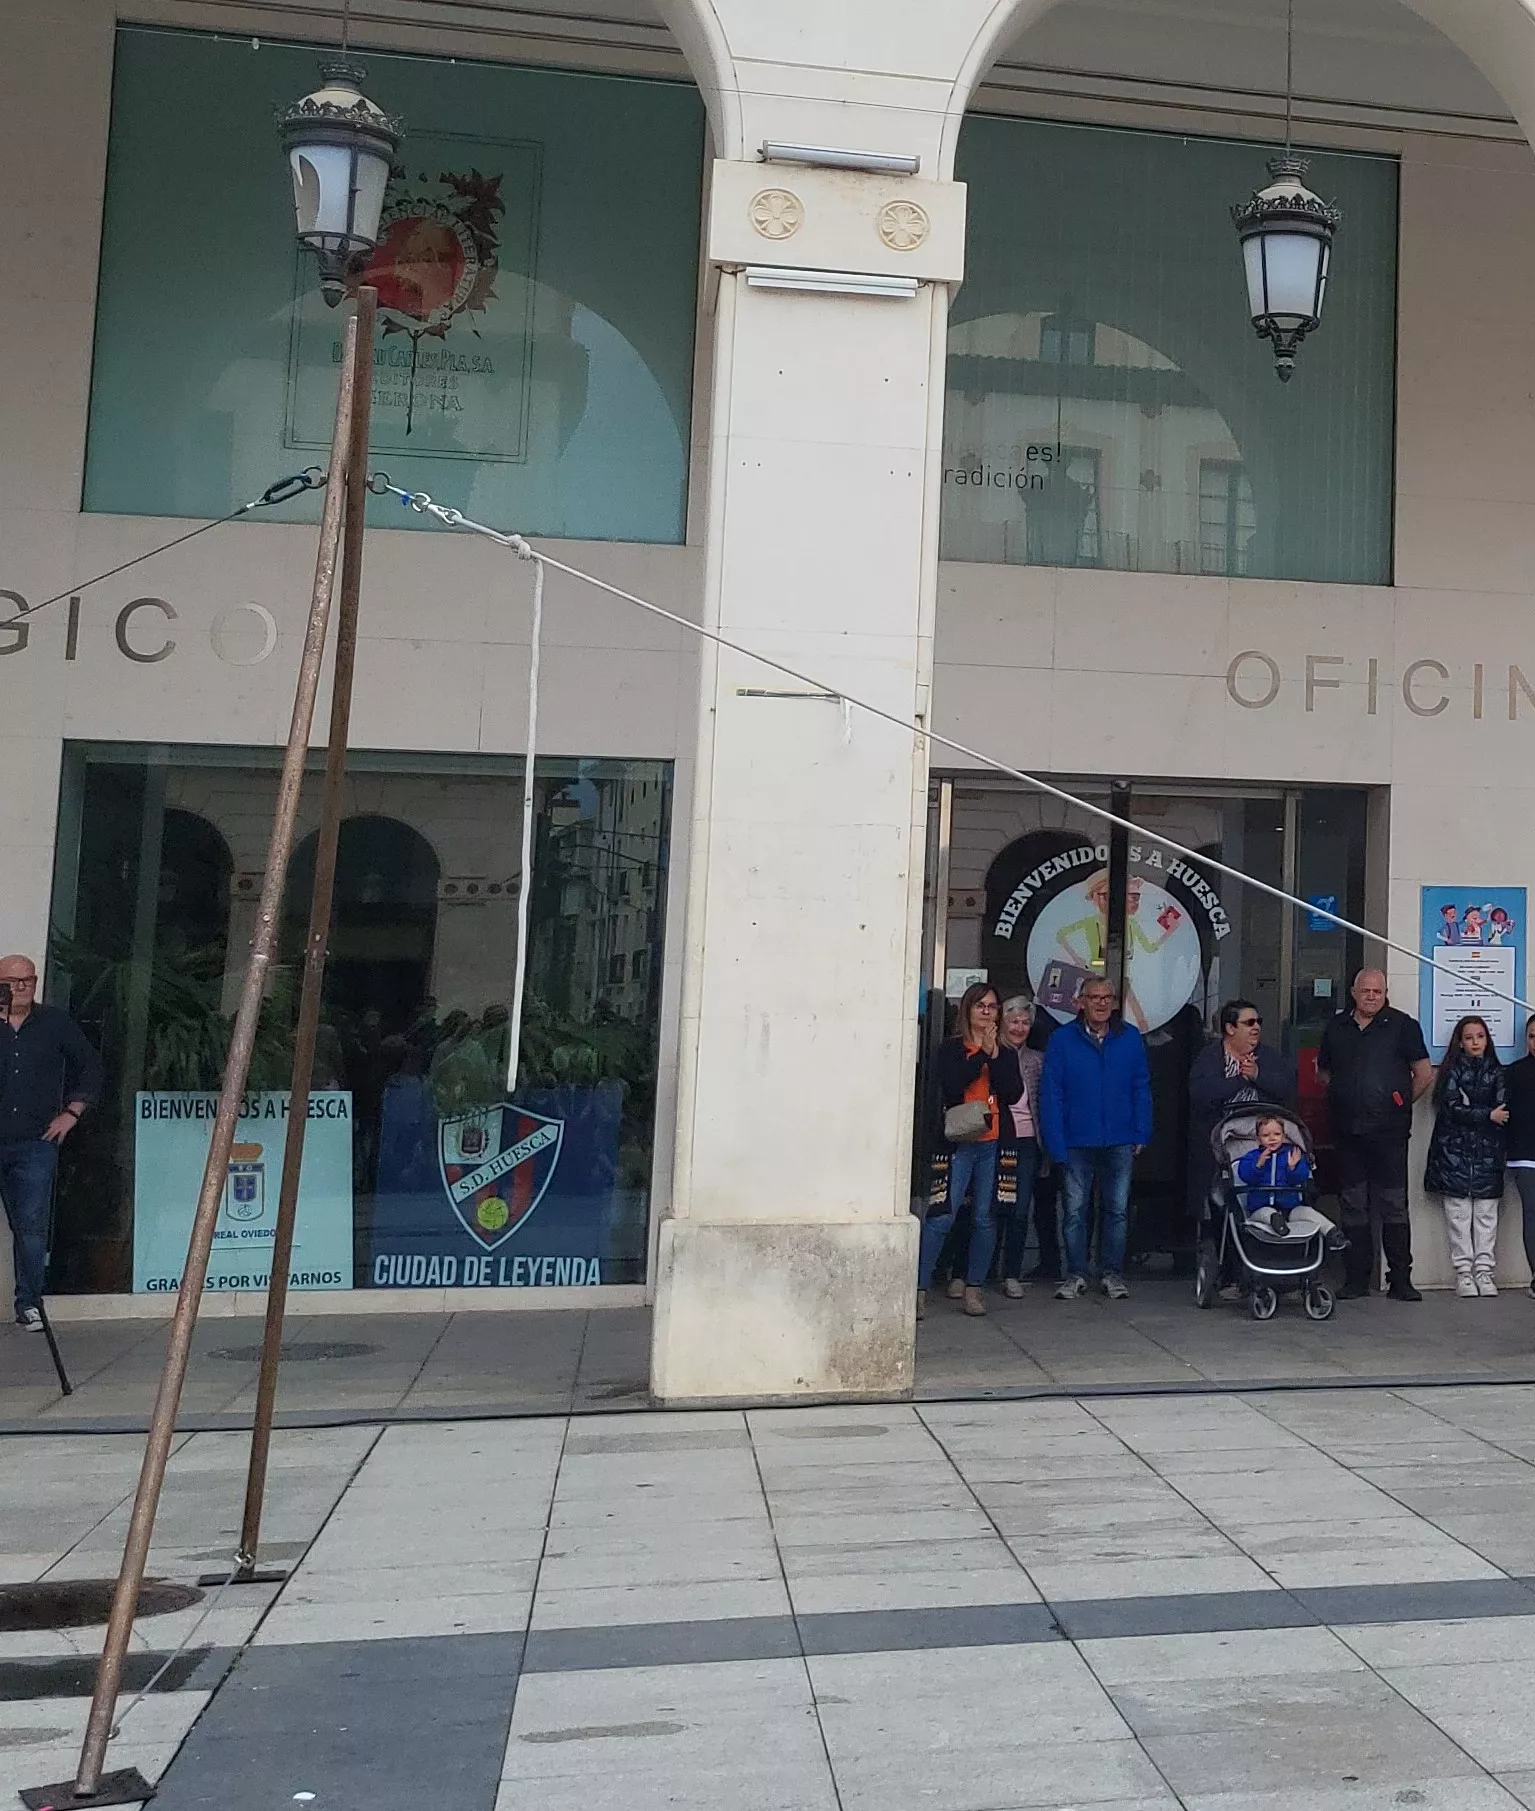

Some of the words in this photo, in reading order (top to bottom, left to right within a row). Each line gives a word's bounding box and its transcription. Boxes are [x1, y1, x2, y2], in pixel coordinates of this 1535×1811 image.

[1026, 442, 1060, 462] es!
[943, 464, 1044, 490] radición
[993, 845, 1142, 940] BIENVENIDOS
[1145, 850, 1163, 868] A
[1166, 858, 1232, 940] HUESCA
[141, 1099, 260, 1120] BIENVENOS
[264, 1099, 277, 1119] A
[281, 1099, 348, 1119] HESCA
[459, 1172, 489, 1194] S.D.
[490, 1131, 551, 1176] HUESCA
[213, 1230, 239, 1239] REAL
[241, 1228, 277, 1239] OVIEDO
[146, 1276, 214, 1291] GRAS
[218, 1275, 250, 1288] POR
[255, 1271, 342, 1288] VIARNOS
[374, 1254, 457, 1286] CIUDAD
[463, 1255, 493, 1286] DE
[498, 1255, 601, 1287] LEYENDA
